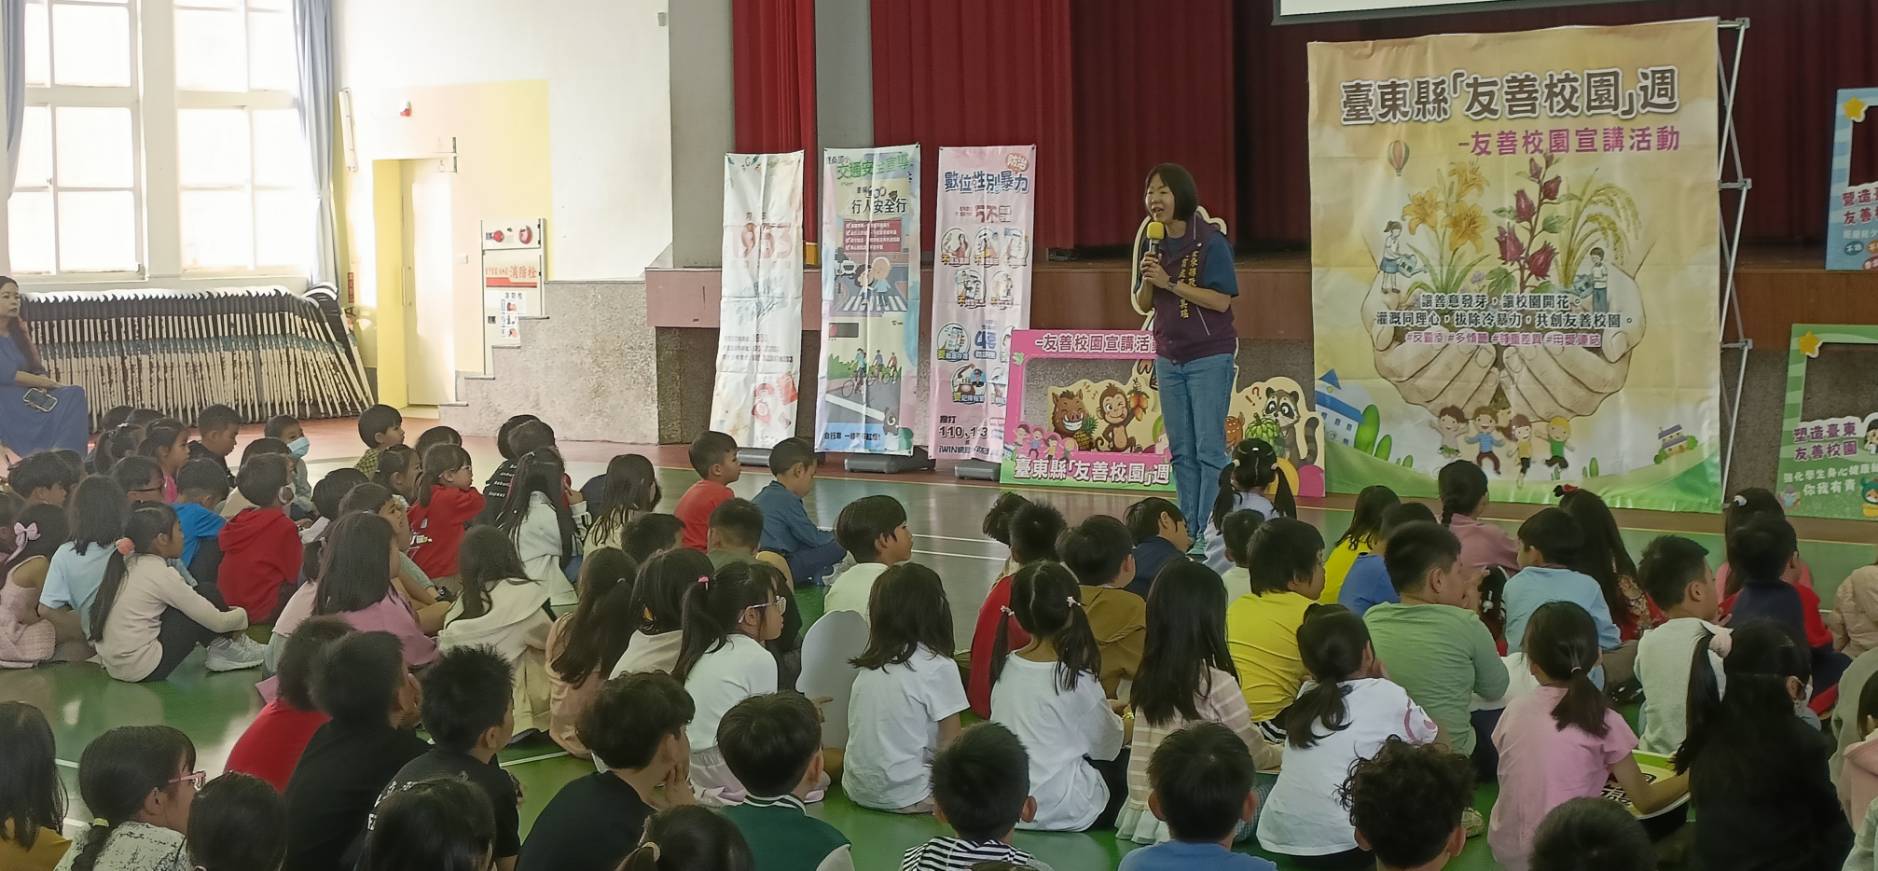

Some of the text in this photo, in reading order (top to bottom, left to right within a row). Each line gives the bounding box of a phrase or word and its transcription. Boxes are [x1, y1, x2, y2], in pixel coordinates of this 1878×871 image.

[1341, 67, 1678, 123] 臺東縣「友善校園」週
[1458, 126, 1680, 155] -友善校園宣講活動
[944, 170, 1029, 192] 數位性別暴力
[852, 199, 907, 214] 行人安全行
[1794, 422, 1856, 442] 塑造臺東
[1795, 440, 1857, 460] 友善校園
[1015, 458, 1171, 485] 臺東縣「友善校園」週
